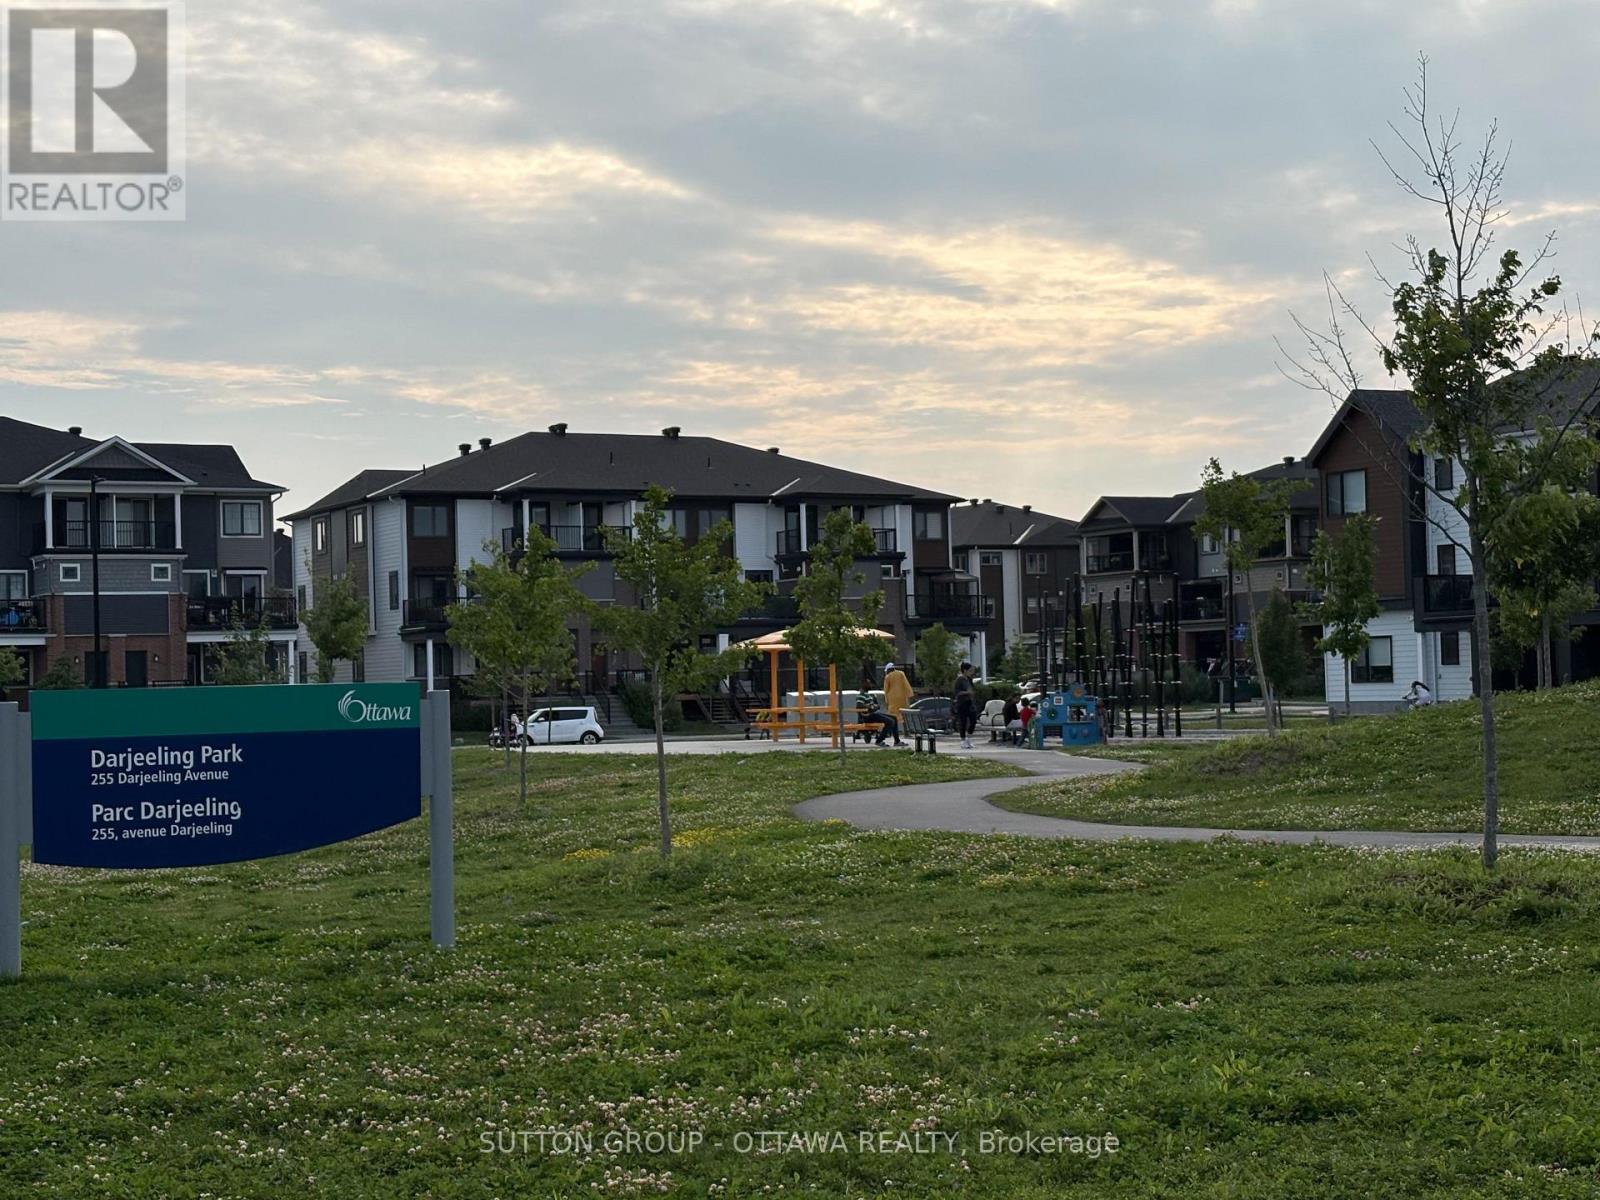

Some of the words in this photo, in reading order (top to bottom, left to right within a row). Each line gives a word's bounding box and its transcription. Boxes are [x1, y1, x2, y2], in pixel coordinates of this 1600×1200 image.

[340, 694, 411, 722] Ottawa
[91, 746, 194, 771] Darjeeling
[201, 743, 244, 763] Park
[91, 773, 114, 785] 255
[118, 770, 181, 786] Darjeeling
[184, 769, 229, 780] Avenue
[92, 804, 134, 822] Parc
[140, 797, 242, 823] Darjeeling
[92, 827, 118, 841] 255,
[122, 826, 167, 839] avenue
[170, 821, 233, 838] Darjeeling
